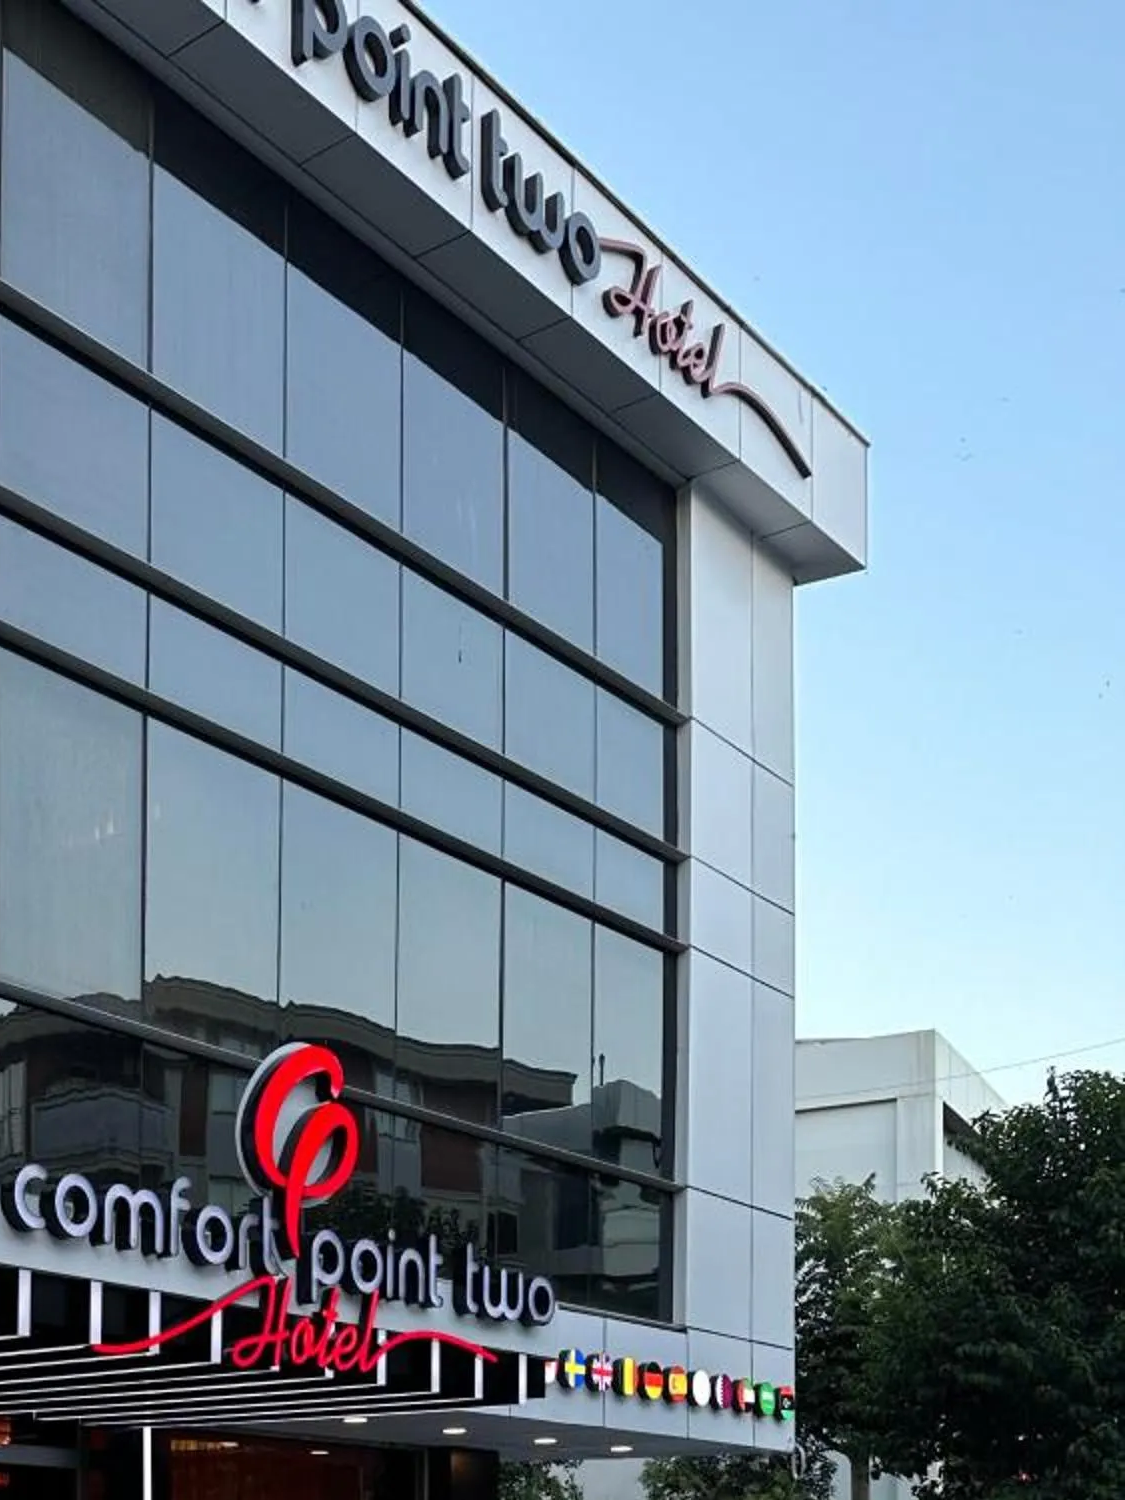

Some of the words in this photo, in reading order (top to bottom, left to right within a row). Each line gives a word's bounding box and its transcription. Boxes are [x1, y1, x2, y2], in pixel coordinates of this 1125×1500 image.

[481, 109, 601, 285] two
[602, 258, 727, 397] Hotel
[12, 1164, 278, 1276] comfort
[309, 1229, 445, 1306] point
[465, 1242, 557, 1324] two
[232, 1275, 385, 1373] Hotel
